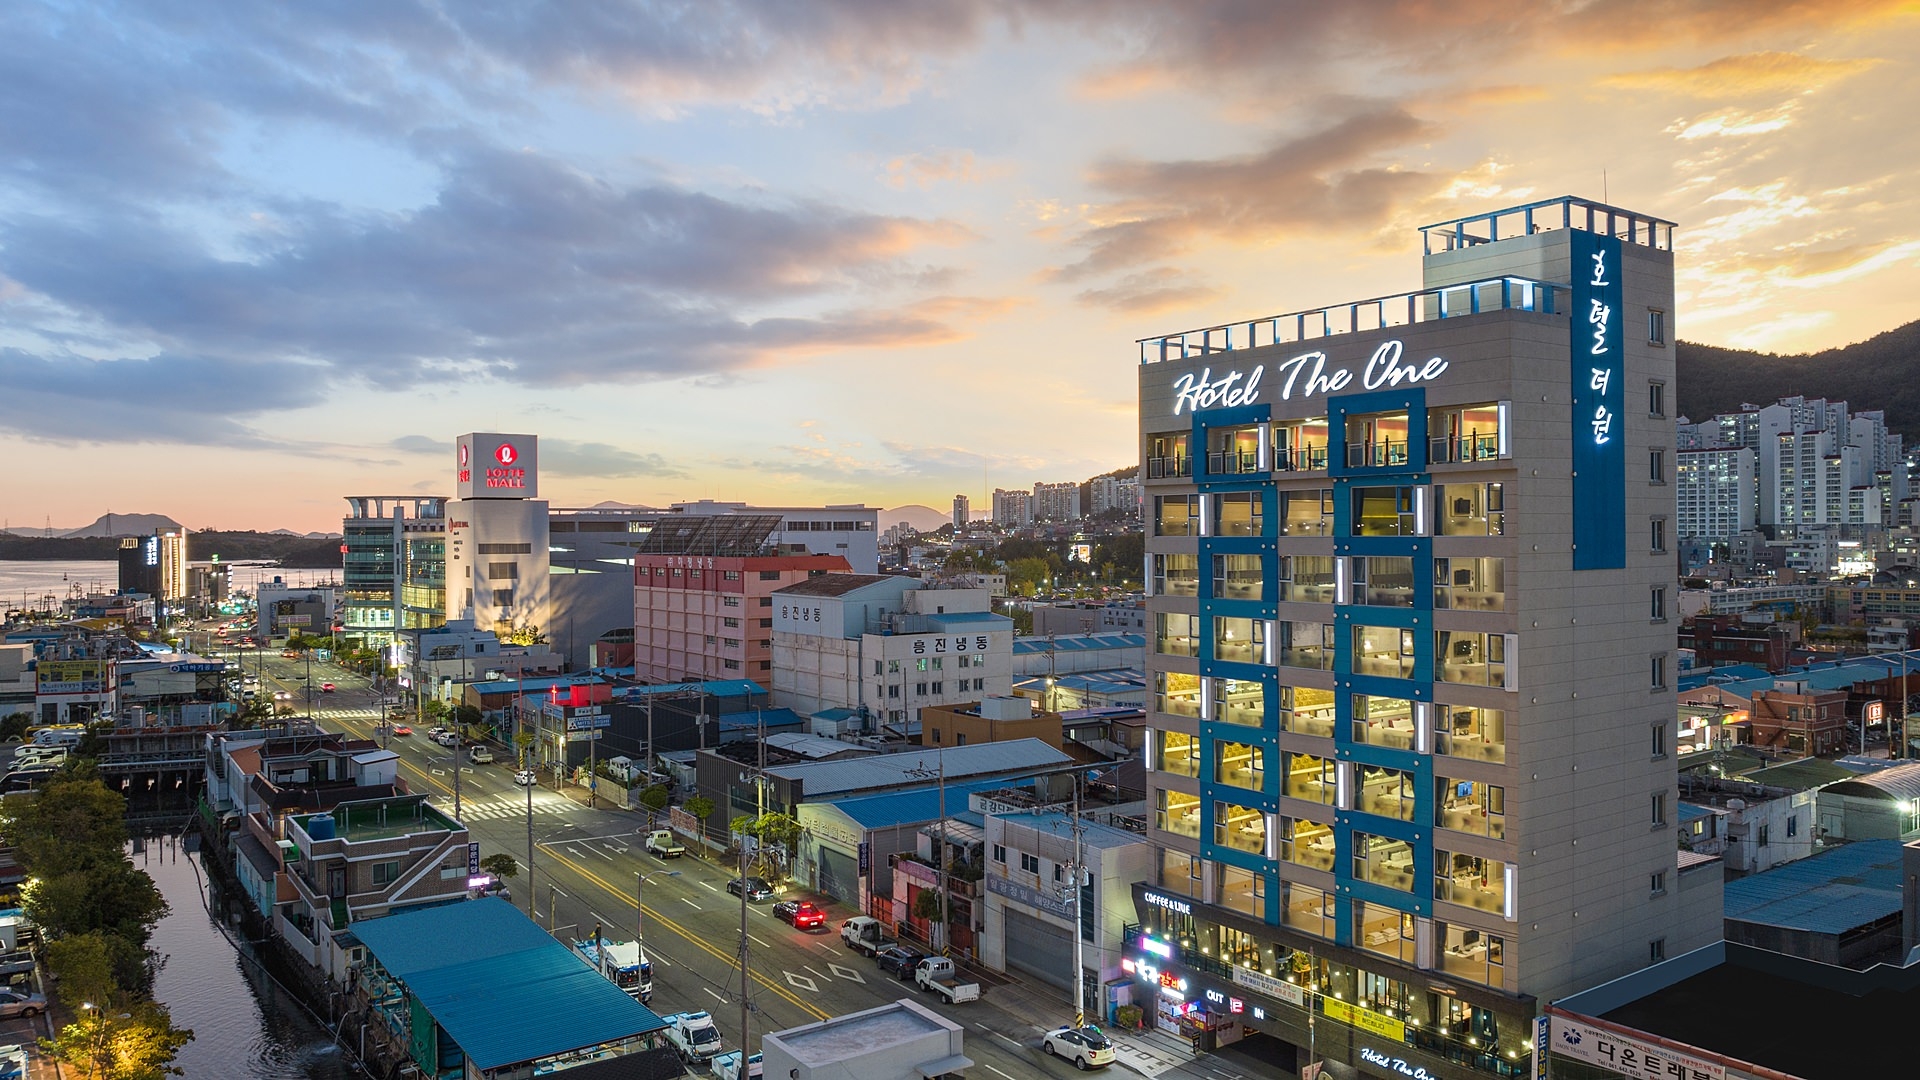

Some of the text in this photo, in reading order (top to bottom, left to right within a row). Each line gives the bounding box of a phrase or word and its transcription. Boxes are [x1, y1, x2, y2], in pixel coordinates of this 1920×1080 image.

[1173, 340, 1449, 416] Hotel The One
[486, 468, 525, 477] LOTTE
[486, 478, 526, 488] MALL
[912, 635, 988, 654] 흥진냉동
[1206, 989, 1224, 1004] OUT
[1254, 1007, 1264, 1020] IN
[1570, 1046, 1589, 1057] TRAVEL
[1361, 1048, 1390, 1069] Hotel
[1392, 1058, 1413, 1076] The
